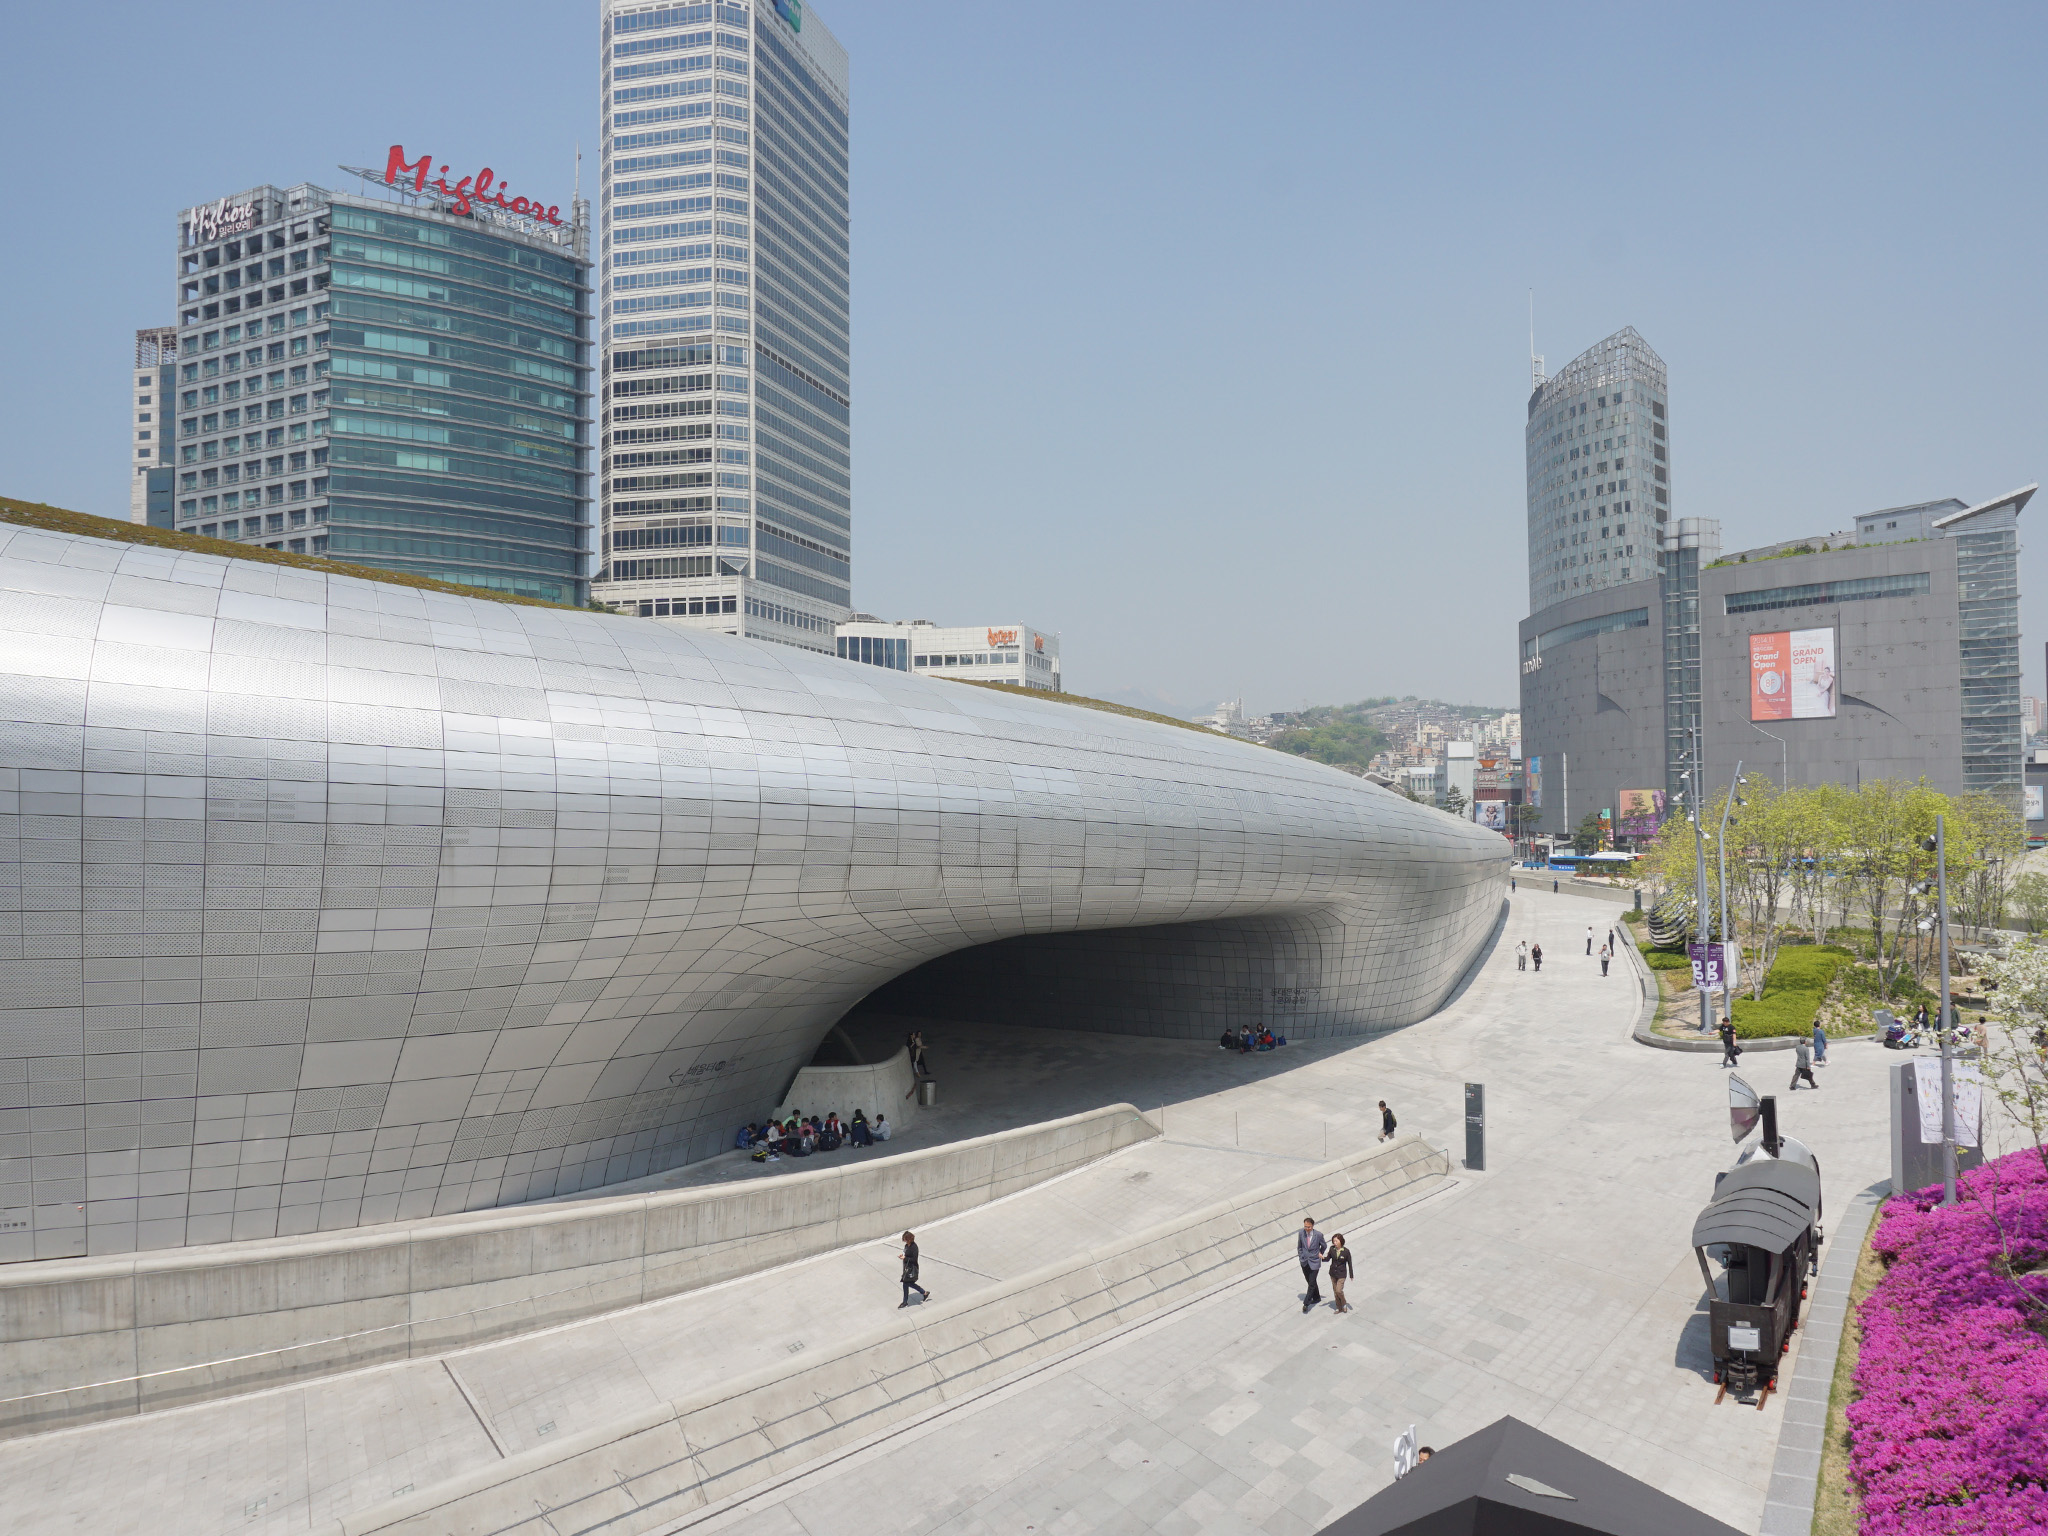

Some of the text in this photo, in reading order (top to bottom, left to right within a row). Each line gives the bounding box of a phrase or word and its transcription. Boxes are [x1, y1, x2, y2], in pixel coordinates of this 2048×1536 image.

[385, 145, 563, 226] Migliore
[189, 197, 252, 241] Migliore
[219, 219, 251, 237] 밀리오레
[1753, 651, 1779, 661] Grand
[1793, 648, 1824, 657] GRAND
[1753, 661, 1776, 670] Open
[1793, 657, 1817, 665] OPEN
